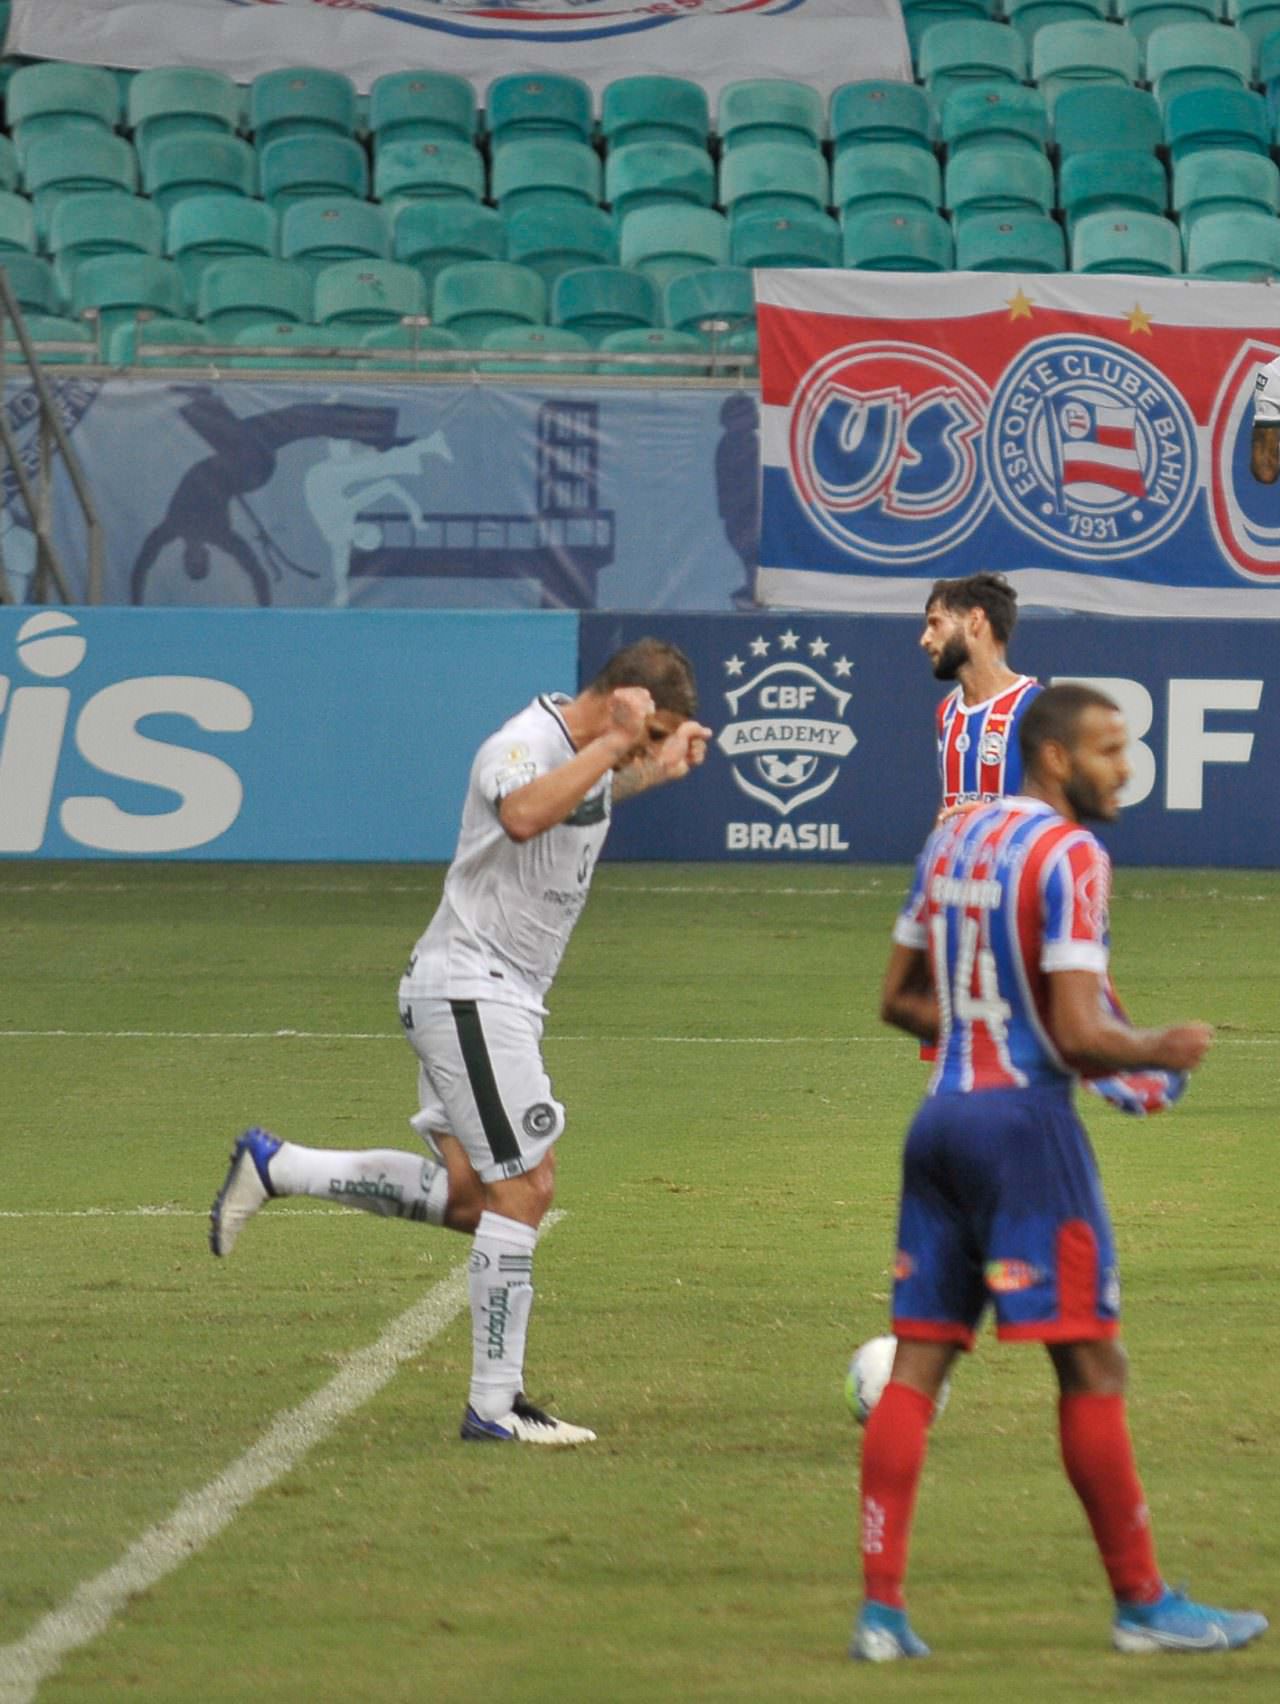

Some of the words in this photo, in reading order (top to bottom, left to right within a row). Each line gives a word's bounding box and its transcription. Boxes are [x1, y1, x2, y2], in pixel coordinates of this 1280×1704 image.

[805, 390, 984, 515] US
[1003, 361, 1059, 497] ESPORTE
[1063, 355, 1160, 410] CLUBE
[1148, 416, 1182, 506] BAHIA
[1069, 514, 1118, 538] 1931
[0, 610, 254, 853] is
[733, 723, 842, 747] ACADEMY
[760, 685, 816, 710] CBF
[726, 822, 850, 850] BRASIL
[930, 912, 1012, 1040] 14
